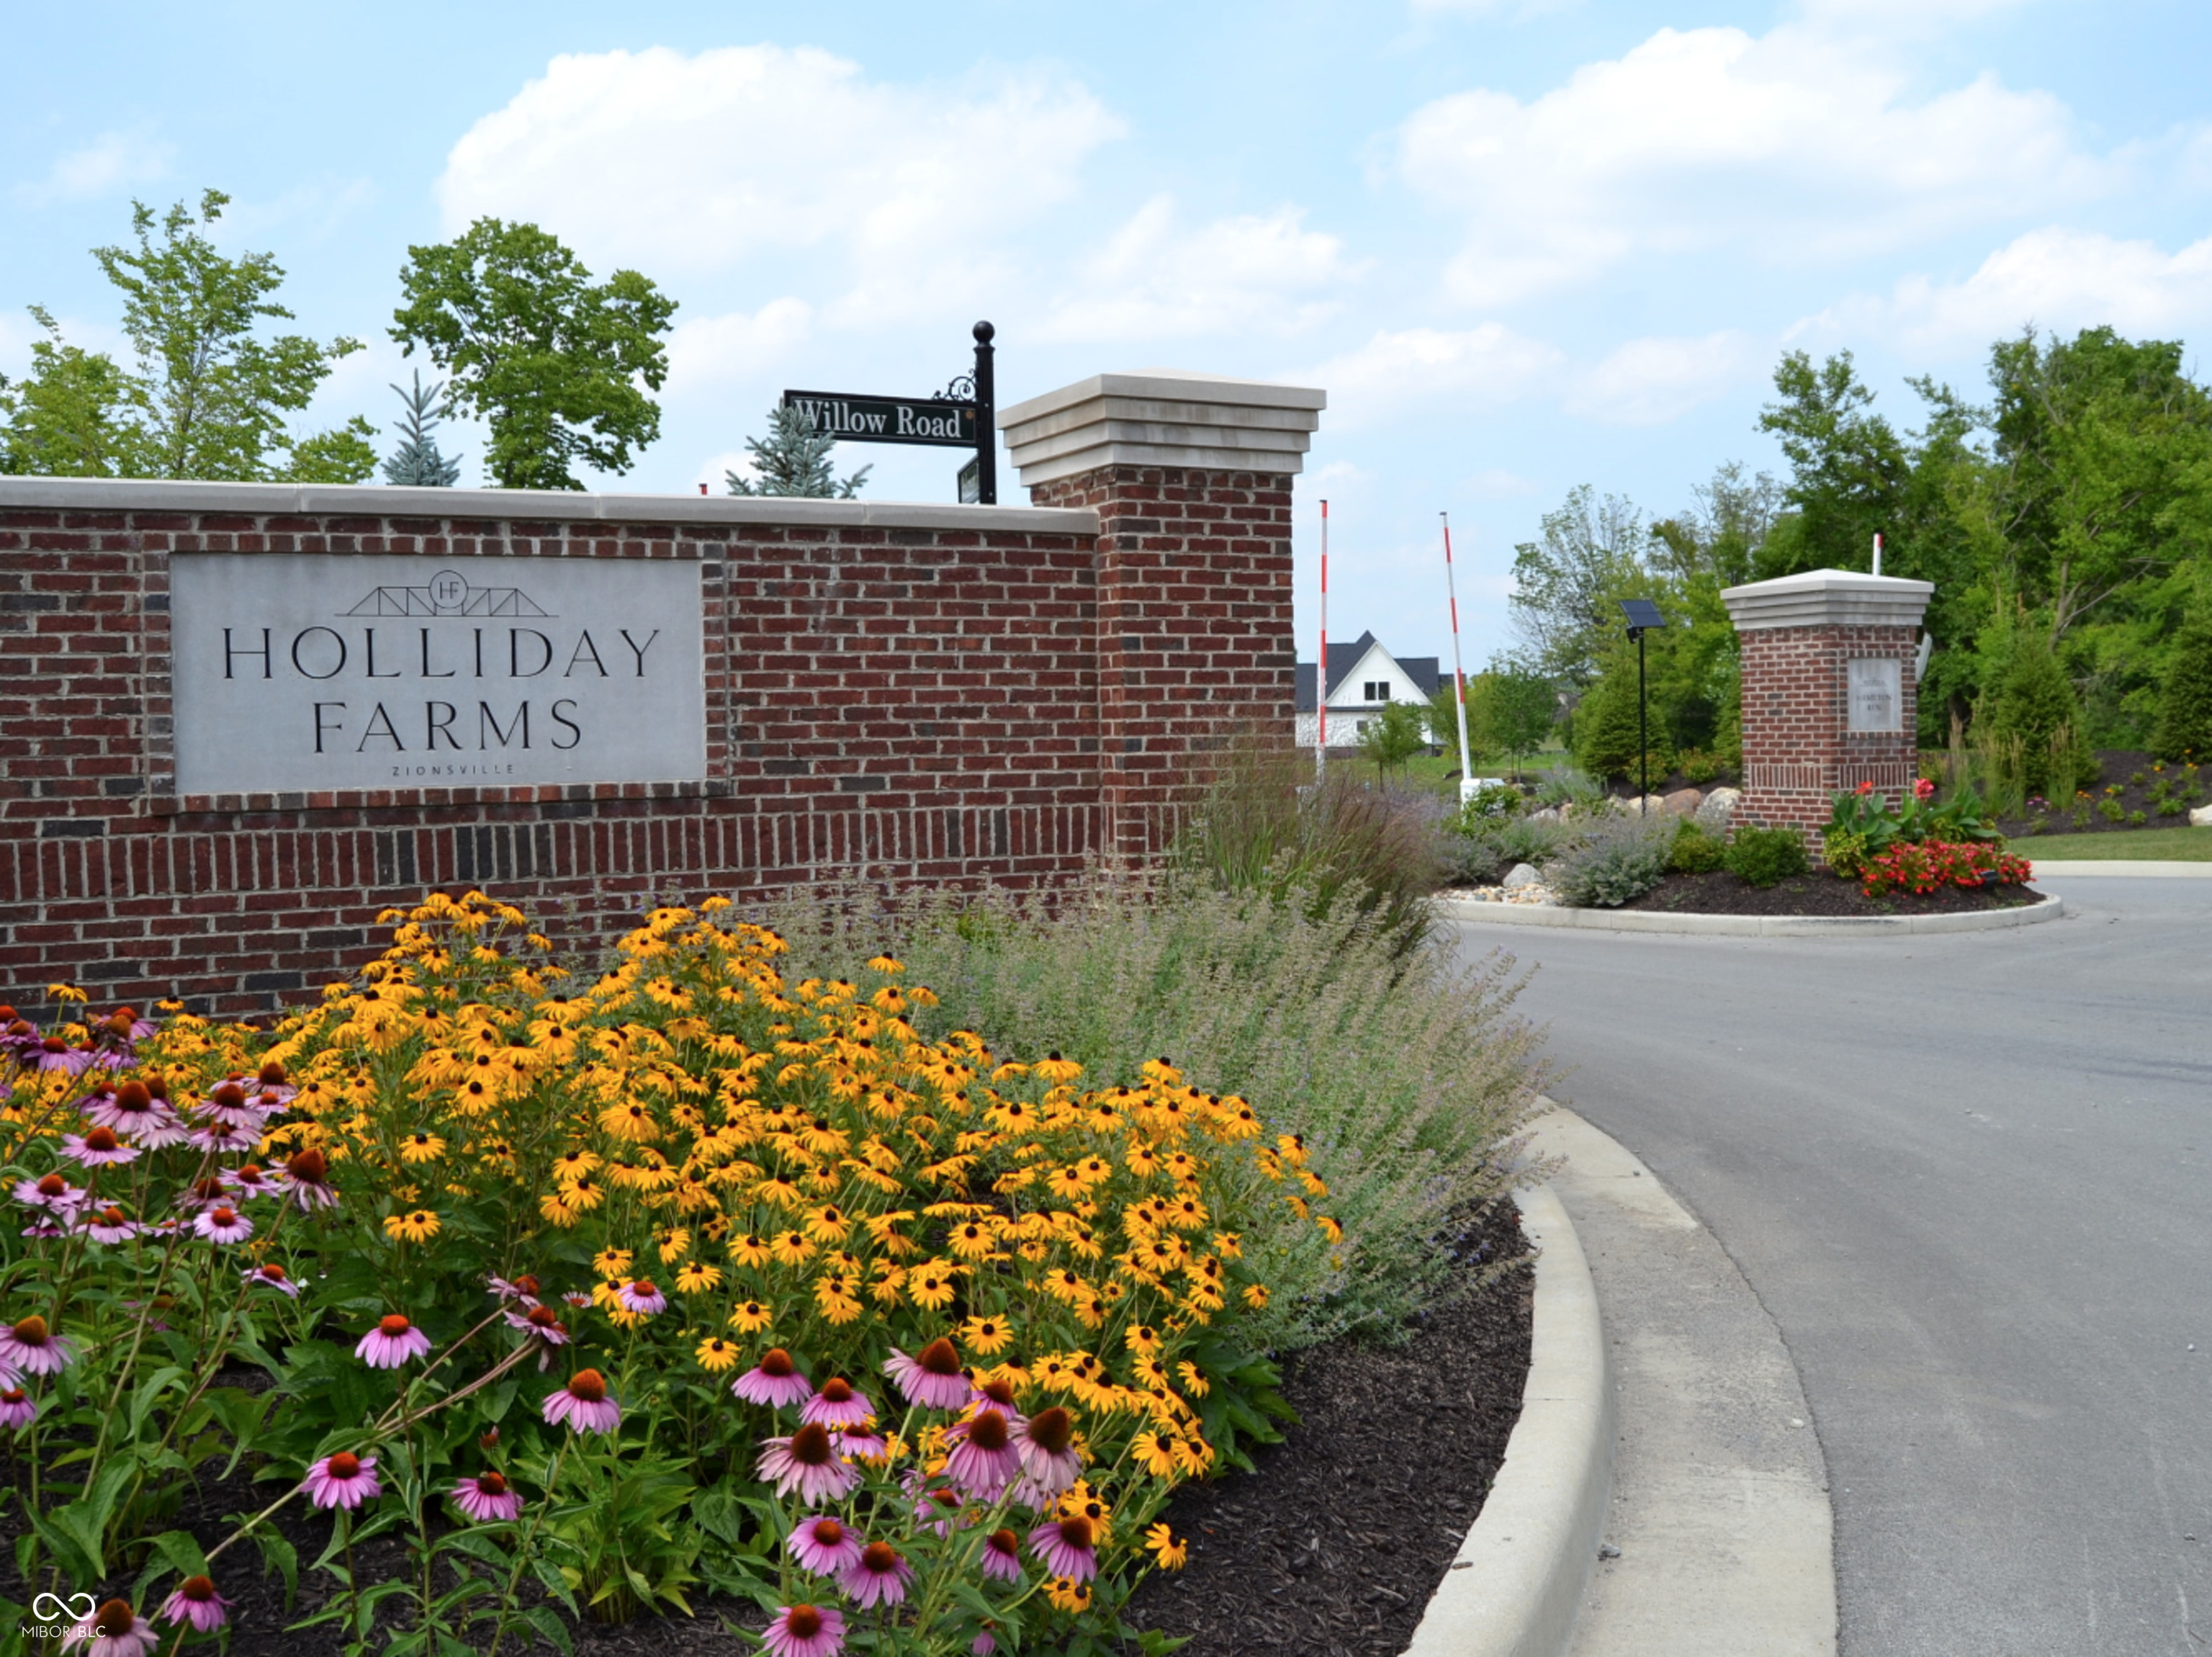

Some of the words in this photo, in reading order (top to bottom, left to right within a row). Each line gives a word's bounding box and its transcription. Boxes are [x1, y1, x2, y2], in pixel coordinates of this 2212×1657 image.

[896, 406, 961, 438] Road
[439, 581, 459, 599] HF
[222, 627, 660, 679] HOLLIDAY
[313, 699, 582, 753] FARMS
[392, 764, 513, 777] ZIONSVILLE
